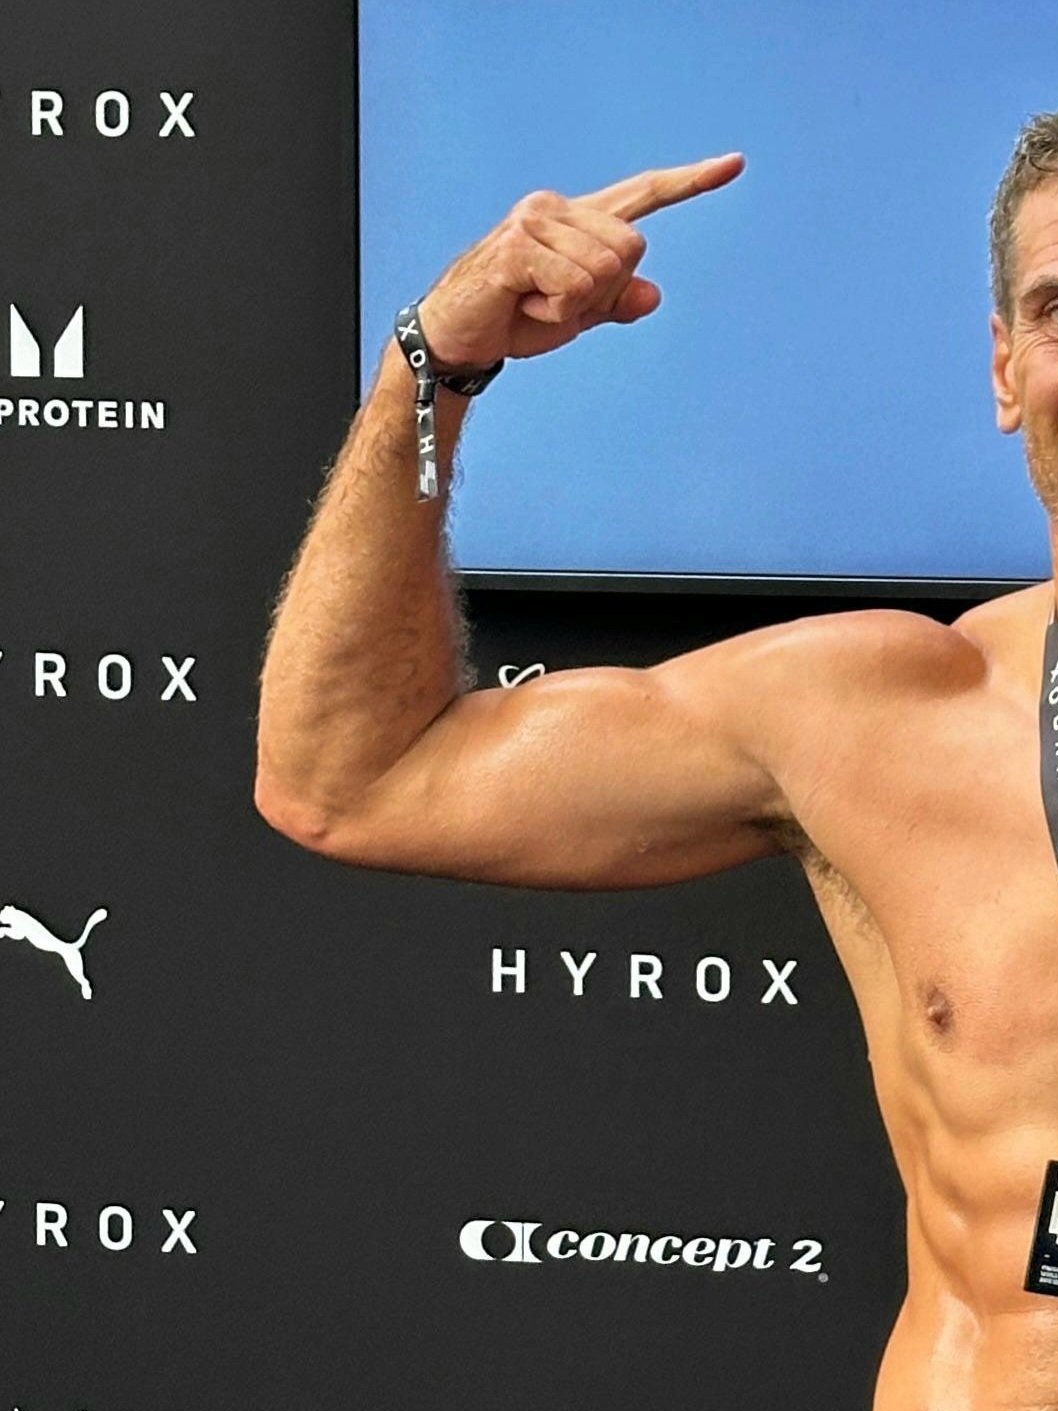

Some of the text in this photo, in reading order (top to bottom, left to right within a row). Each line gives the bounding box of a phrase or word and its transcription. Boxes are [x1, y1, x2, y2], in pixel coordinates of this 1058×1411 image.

[31, 90, 196, 138] ROX
[0, 398, 165, 430] PROTEIN
[0, 651, 197, 702] ROX
[491, 948, 799, 1005] HYROX
[0, 1200, 198, 1254] ROX
[546, 1230, 823, 1273] concept 2
